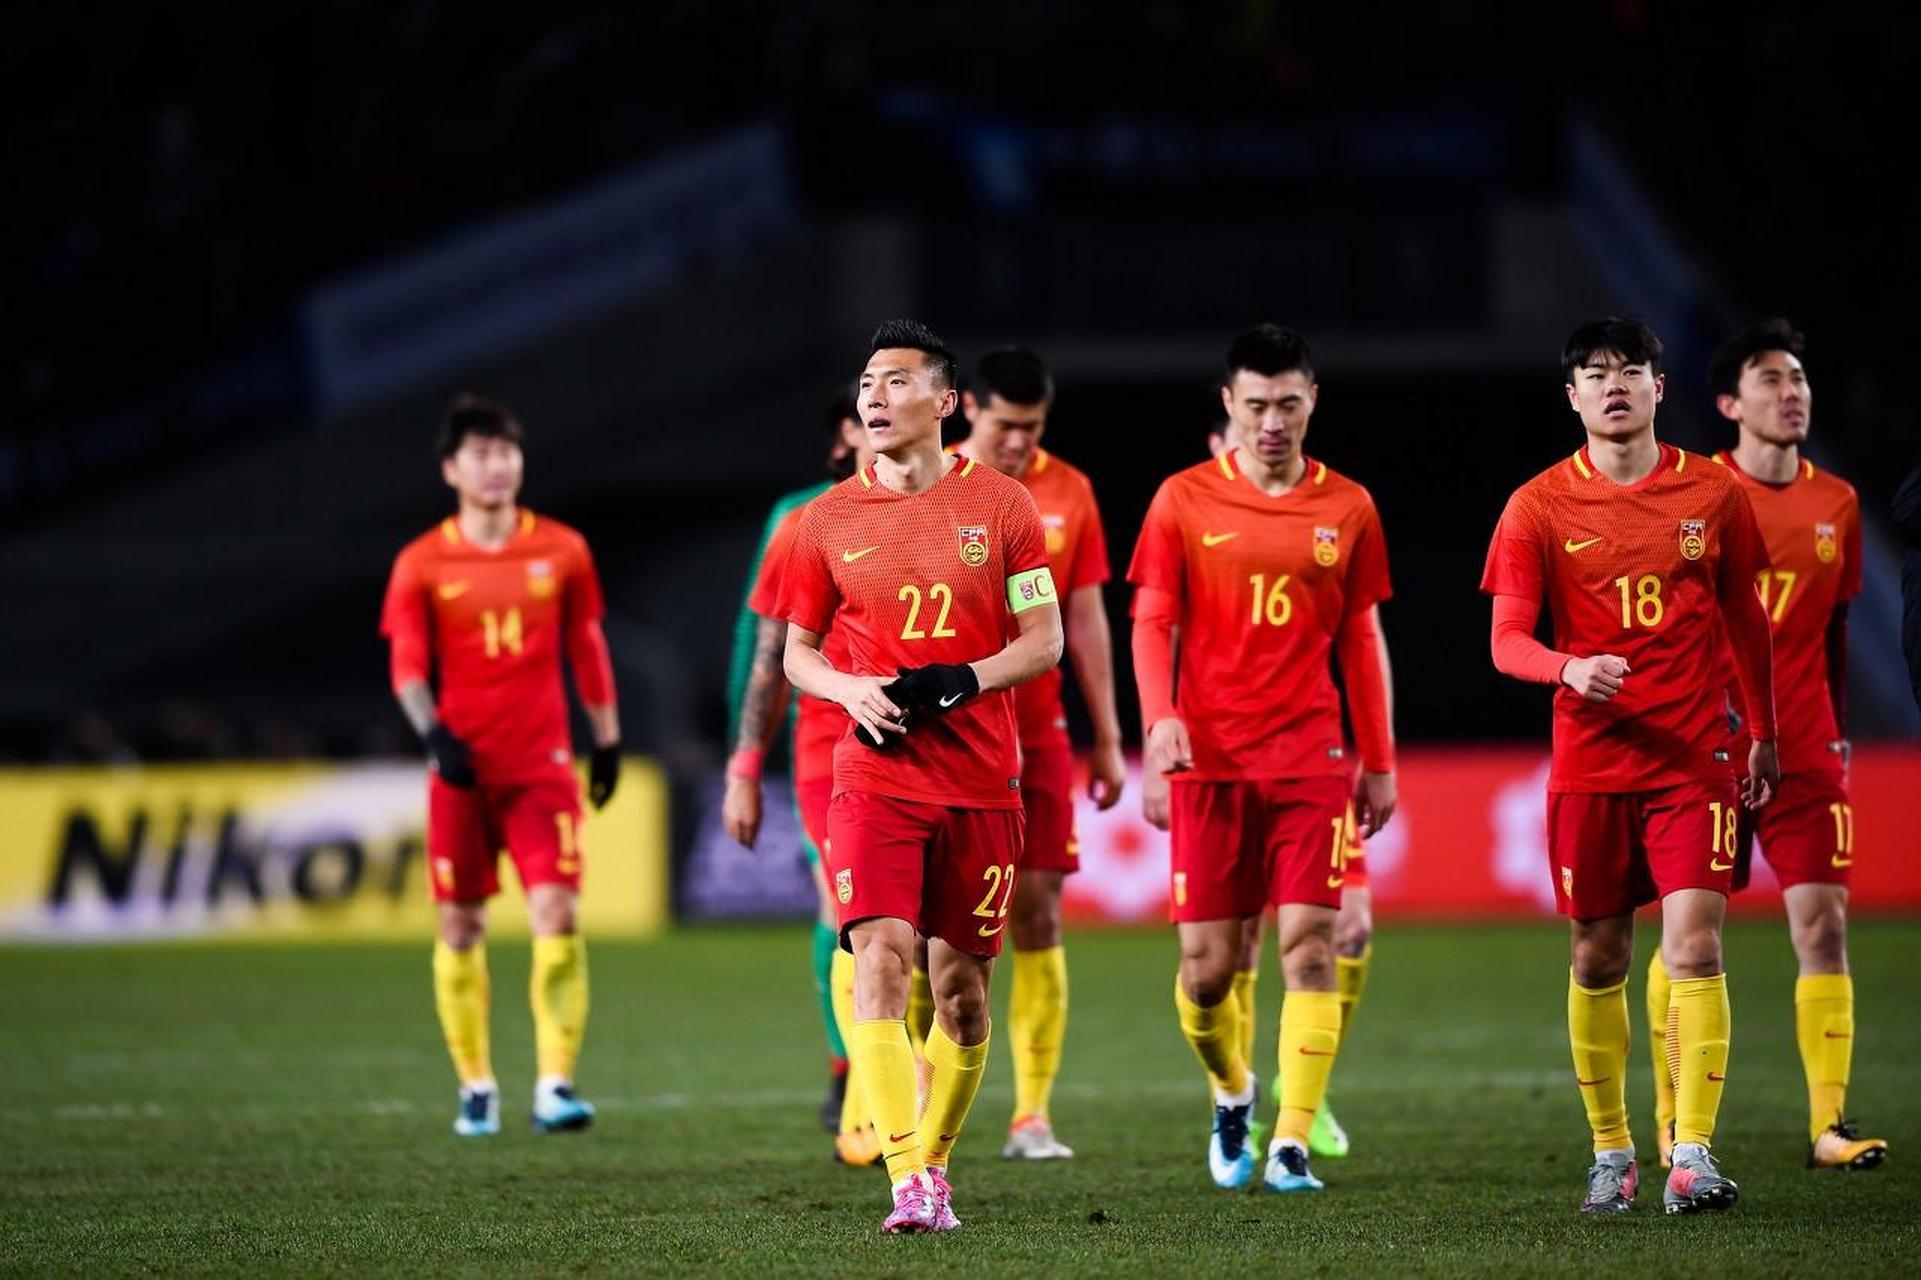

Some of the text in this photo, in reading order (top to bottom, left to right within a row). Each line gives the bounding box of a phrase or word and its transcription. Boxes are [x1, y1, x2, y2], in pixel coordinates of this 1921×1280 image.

[898, 583, 956, 640] 22
[1249, 574, 1292, 626] 16
[1615, 575, 1664, 628] 18
[1756, 570, 1797, 623] 17
[482, 608, 523, 658] 14
[1709, 802, 1737, 859] 18
[972, 864, 1015, 918] 22
